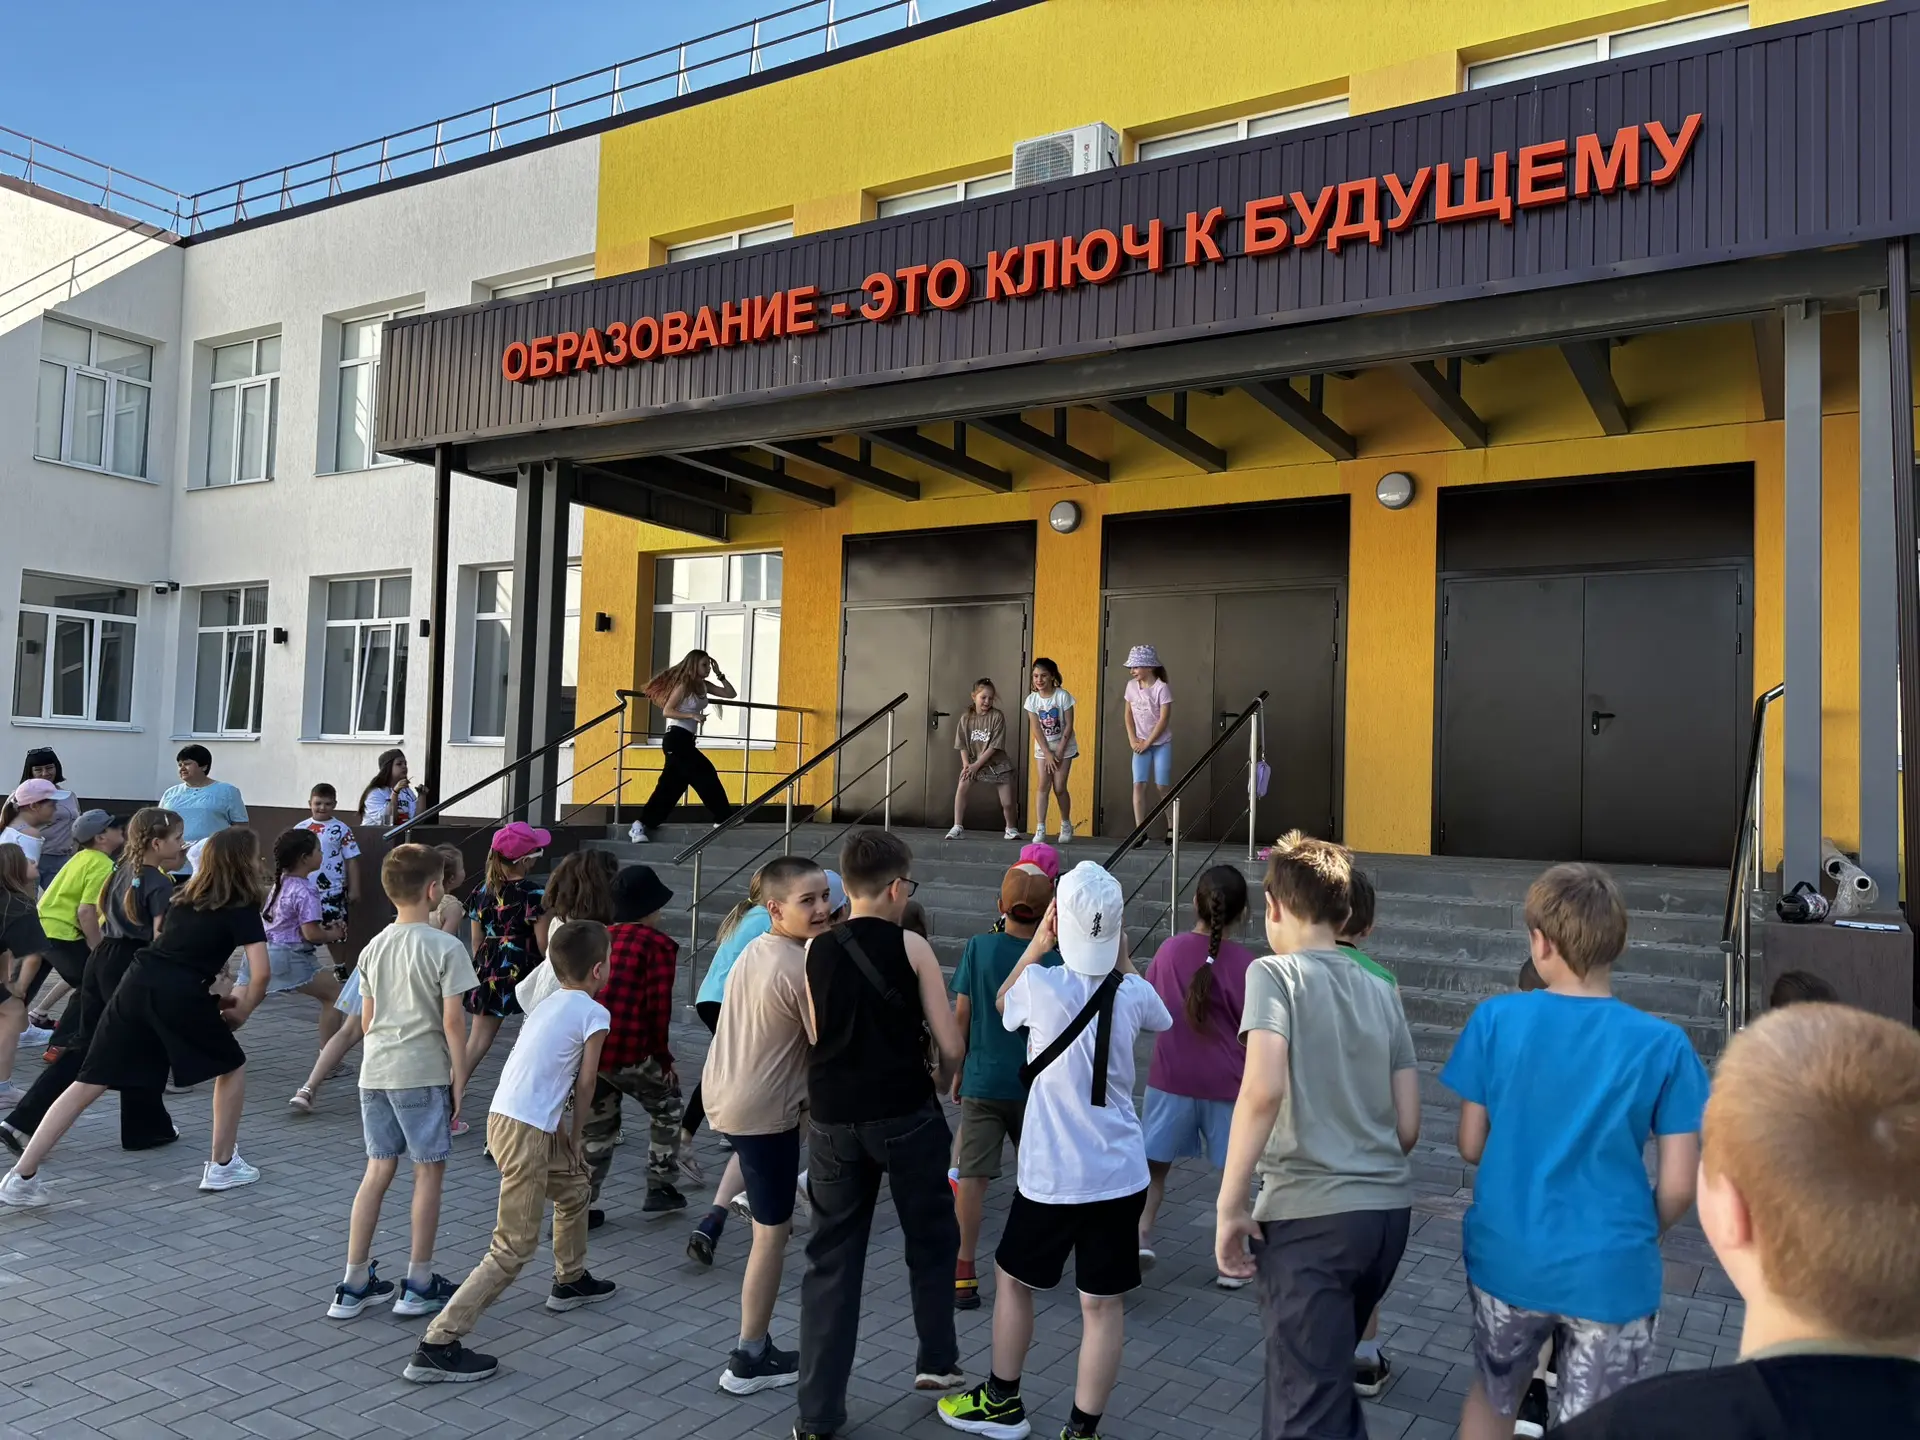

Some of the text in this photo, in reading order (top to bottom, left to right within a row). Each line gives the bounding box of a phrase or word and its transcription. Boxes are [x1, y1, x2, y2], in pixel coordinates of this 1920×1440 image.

[502, 113, 1702, 382] ОБРАЗОВАНИЕ - ЭТО КЛЮЧ К БУДУЩЕМУ
